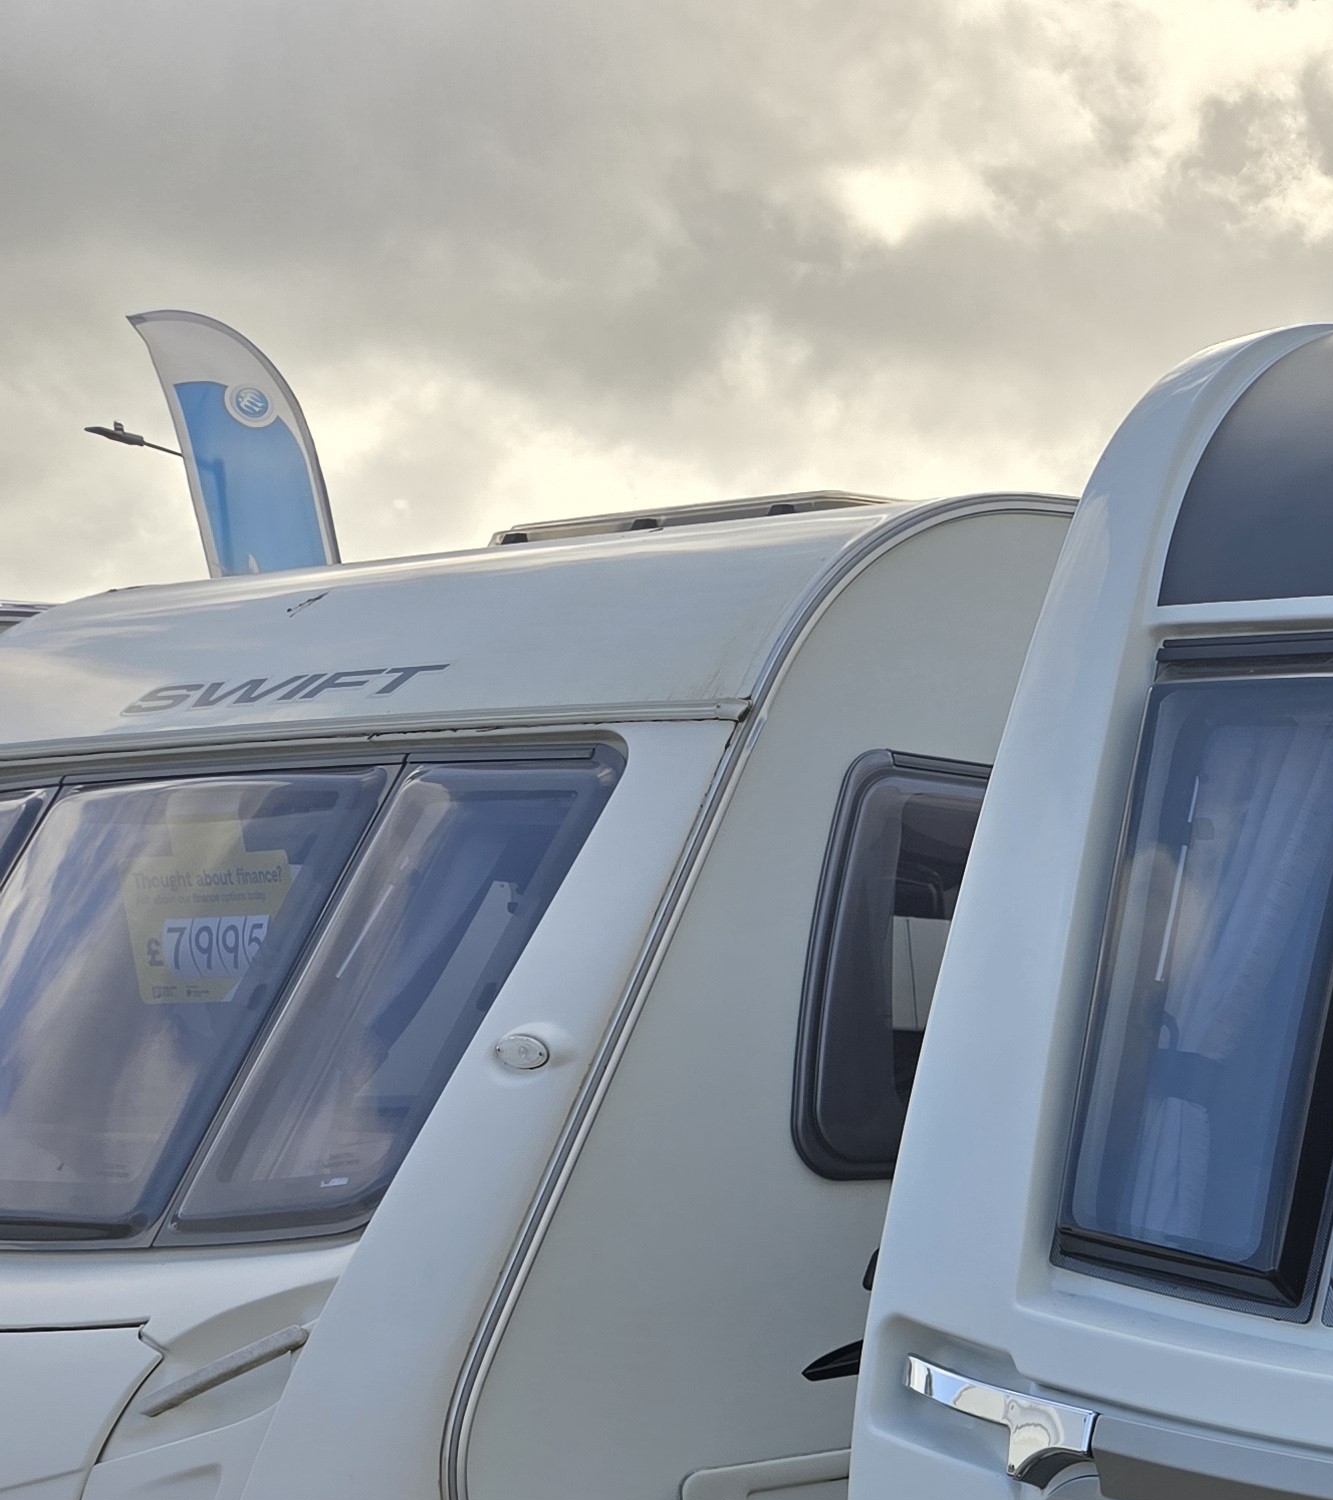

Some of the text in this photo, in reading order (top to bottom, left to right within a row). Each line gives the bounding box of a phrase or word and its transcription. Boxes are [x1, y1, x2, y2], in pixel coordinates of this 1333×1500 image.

[121, 662, 452, 715] SWIFT
[132, 866, 282, 891] Thought about finance?
